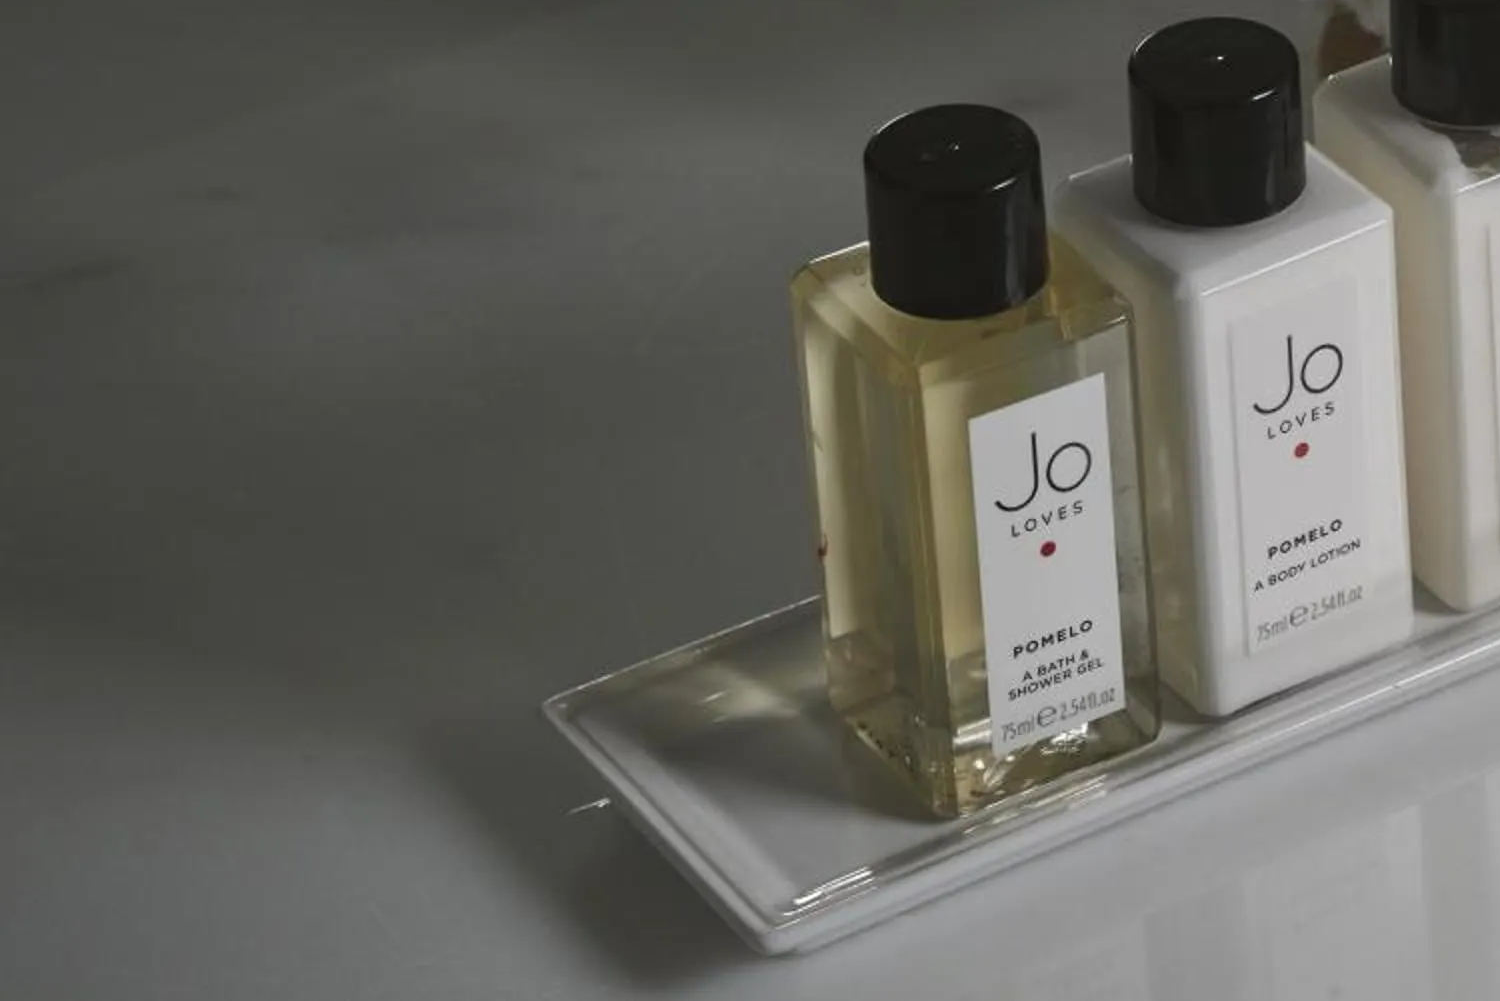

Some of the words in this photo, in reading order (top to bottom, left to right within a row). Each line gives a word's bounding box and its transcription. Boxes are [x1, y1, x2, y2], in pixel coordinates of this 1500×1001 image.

[1253, 334, 1343, 414] Jo
[1267, 401, 1335, 439] LOVES
[994, 432, 1091, 512] Jo
[1010, 500, 1084, 538] LOVES
[1267, 518, 1343, 560] POMELO
[1253, 579, 1264, 592] A
[1267, 561, 1306, 586] BODY
[1310, 538, 1361, 569] LOTION
[1012, 619, 1093, 660] POMELO
[1007, 669, 1073, 702] SHOWER
[1077, 657, 1104, 675] GEL
[1022, 670, 1033, 682] A
[1037, 654, 1075, 676] BATH
[1080, 649, 1089, 660] &
